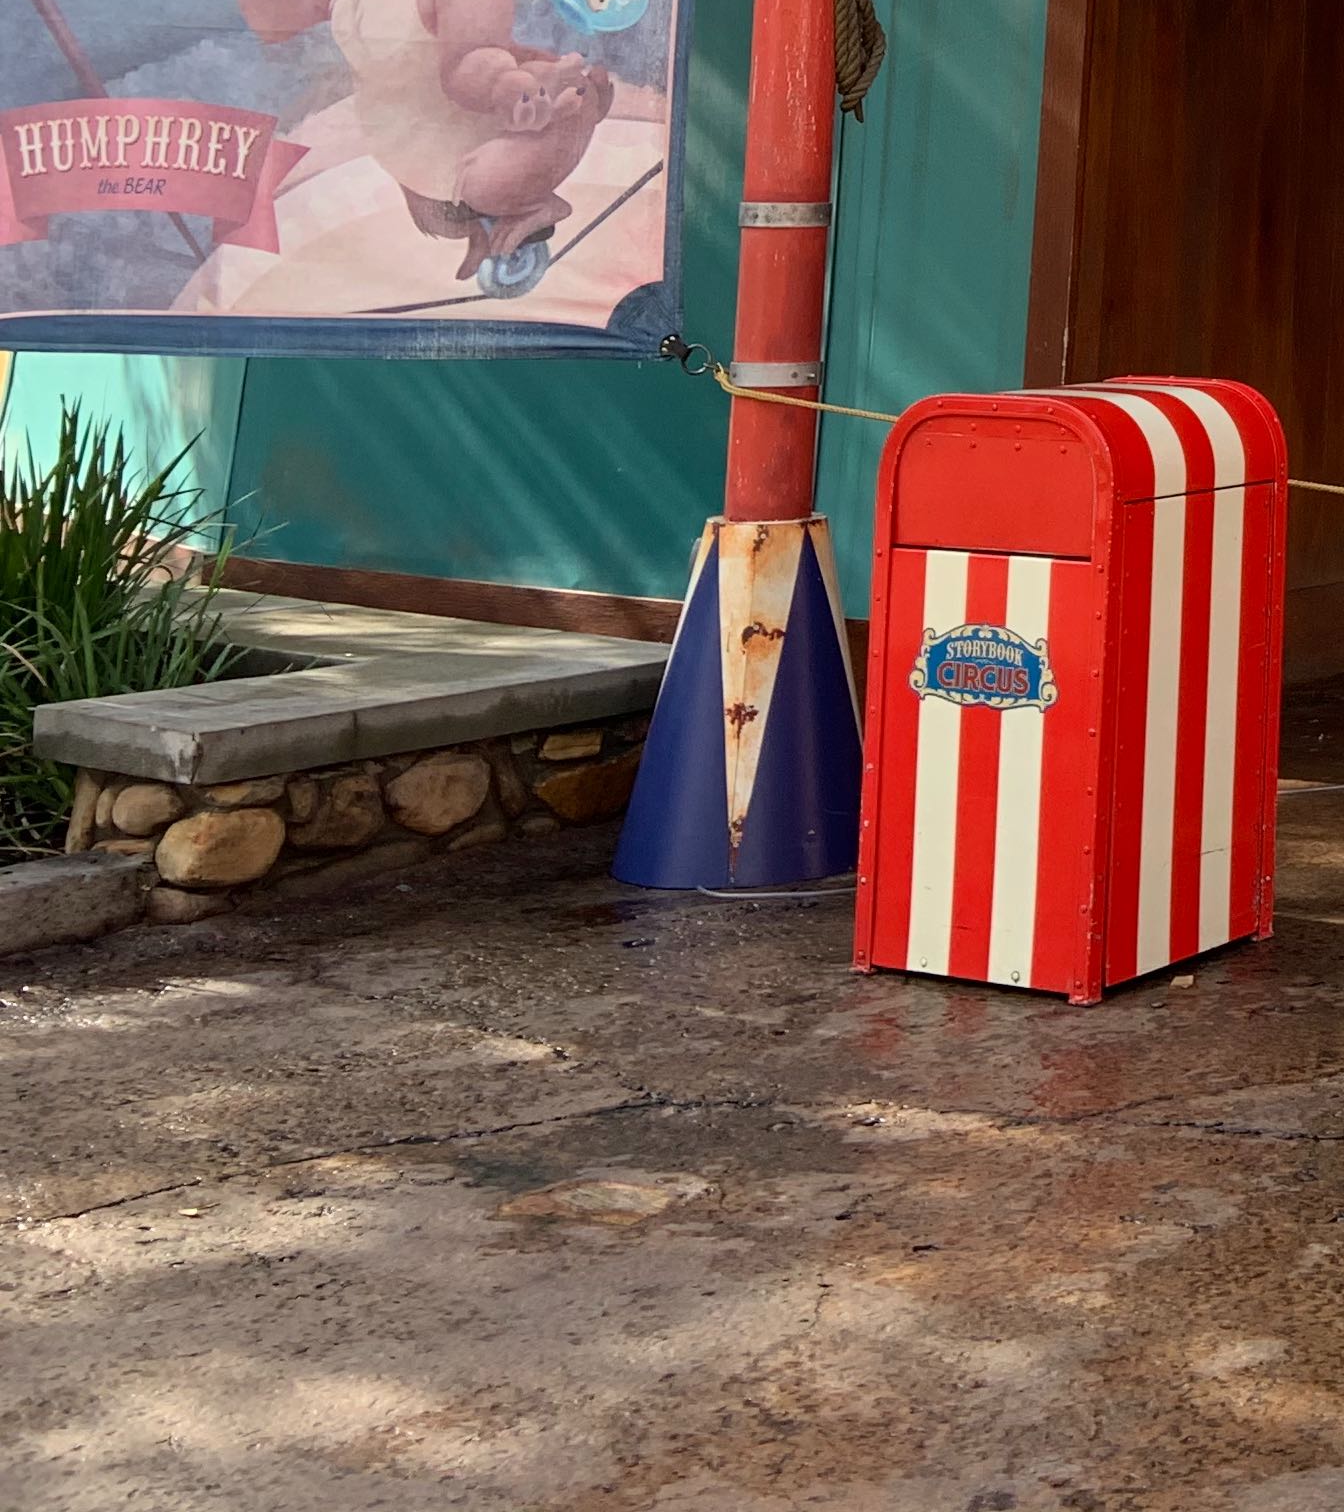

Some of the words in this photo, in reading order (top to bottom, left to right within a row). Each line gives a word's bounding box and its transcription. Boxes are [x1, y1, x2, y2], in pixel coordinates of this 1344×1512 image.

[14, 114, 262, 179] HUMPHREY
[97, 178, 119, 194] the
[123, 177, 166, 195] BEAR
[946, 640, 1024, 666] STORYBOOK
[937, 661, 1029, 696] CIRCUS
